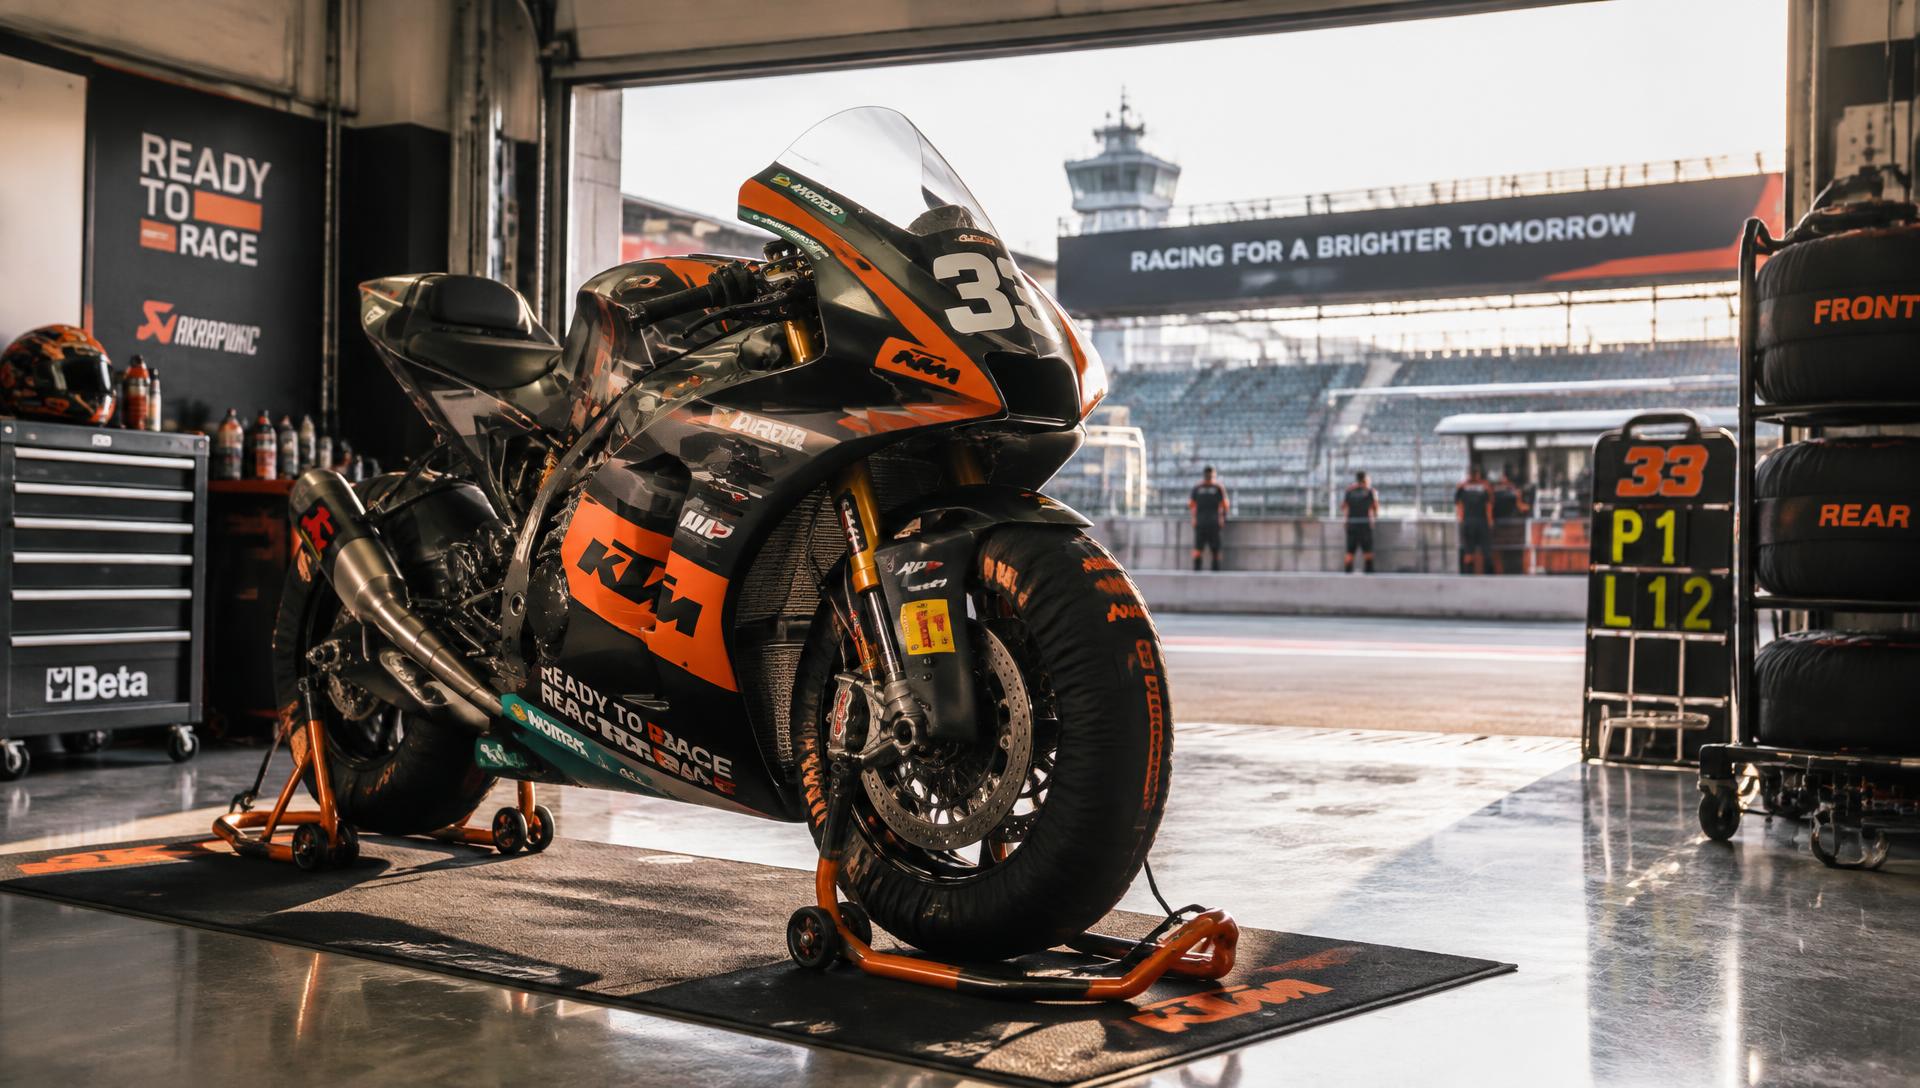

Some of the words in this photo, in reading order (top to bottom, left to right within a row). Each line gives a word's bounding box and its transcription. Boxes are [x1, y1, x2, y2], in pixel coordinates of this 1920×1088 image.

[140, 132, 271, 199] READY
[139, 176, 190, 222] TO
[179, 223, 258, 267] RACE
[1130, 243, 1225, 273] RACING
[1231, 240, 1284, 265] FOR
[1289, 237, 1309, 261] A
[1316, 225, 1452, 259] BRIGHTER
[1459, 211, 1636, 249] TOMORROW
[1813, 295, 1920, 325] FRONT
[1616, 445, 1709, 497] 33
[1818, 503, 1911, 529] REAR
[576, 537, 703, 638] KTM
[74, 665, 149, 701] Beta
[540, 666, 608, 714] READY
[613, 702, 643, 734] TO
